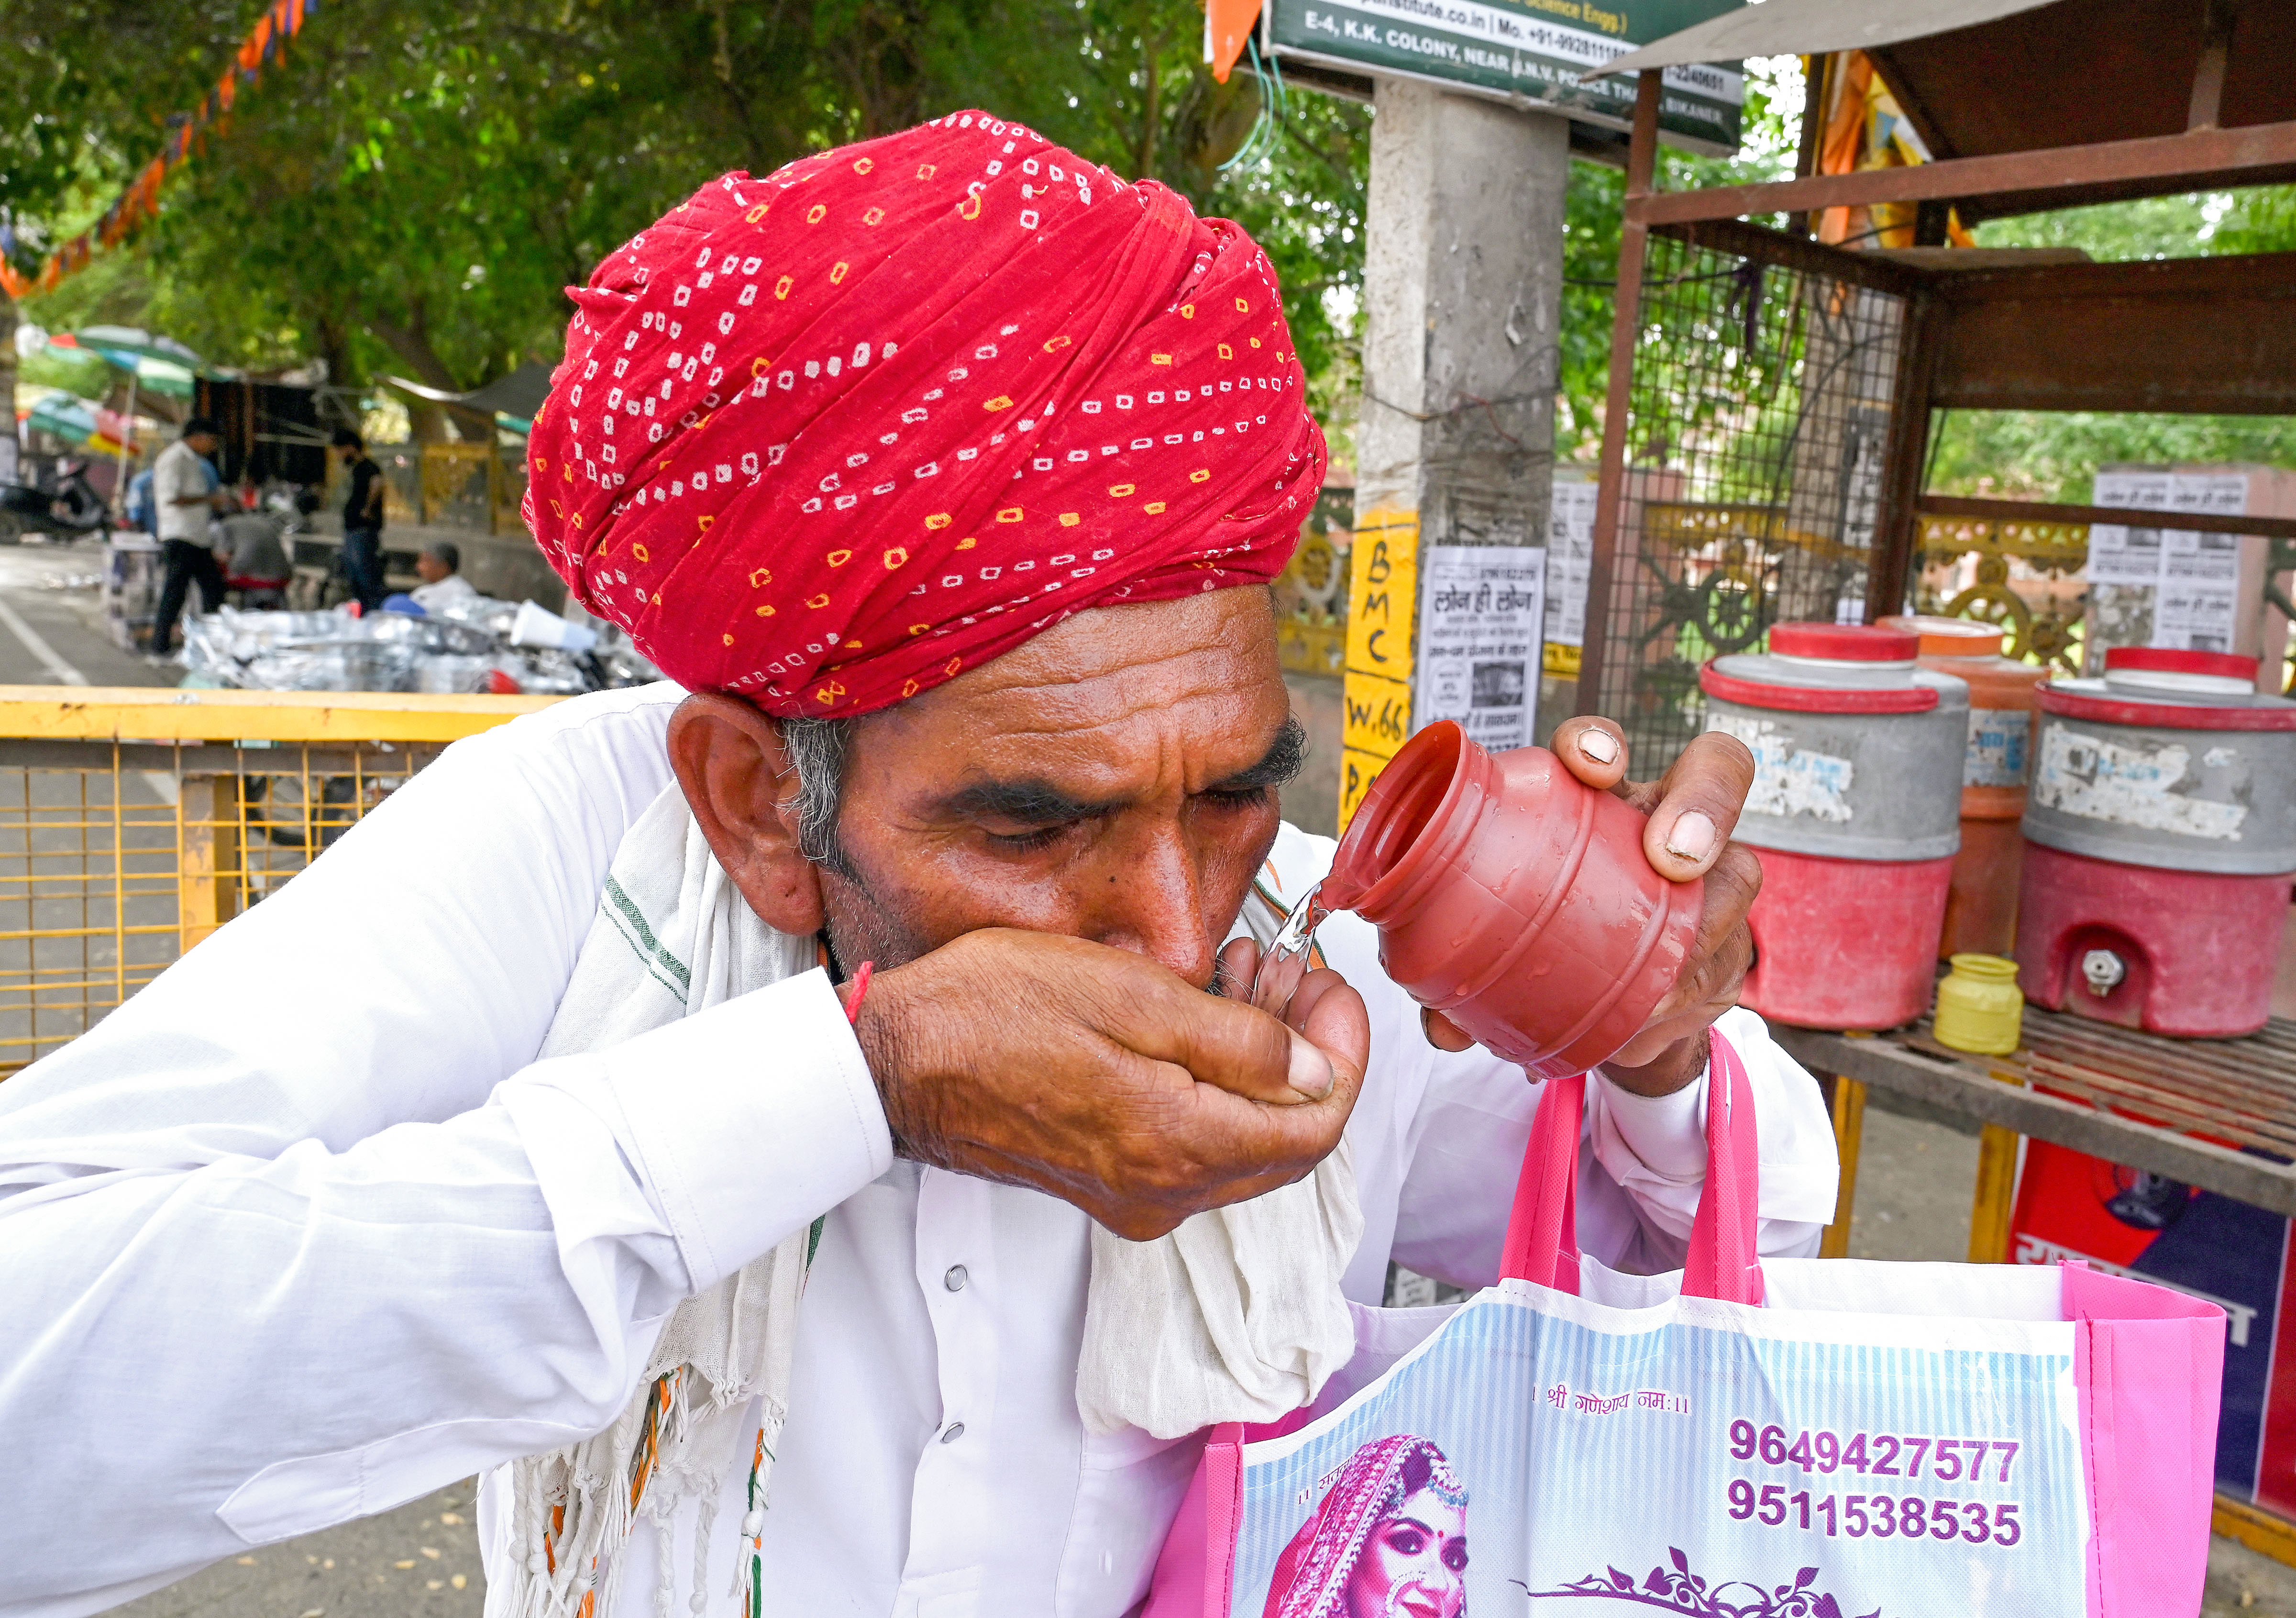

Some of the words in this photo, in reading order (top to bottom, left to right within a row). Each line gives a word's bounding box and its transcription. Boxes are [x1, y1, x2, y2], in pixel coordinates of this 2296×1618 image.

[1305, 10, 1340, 37] E-4,
[1344, 19, 1383, 44] K.K.
[1386, 29, 1461, 63] COLONY,
[1464, 46, 1509, 72] NEAR
[1547, 1384, 1567, 1408] श्री
[1575, 1393, 1630, 1415] गणेशाय
[1729, 1419, 2020, 1482] 9649427577
[1727, 1479, 2021, 1546] 9511538535
